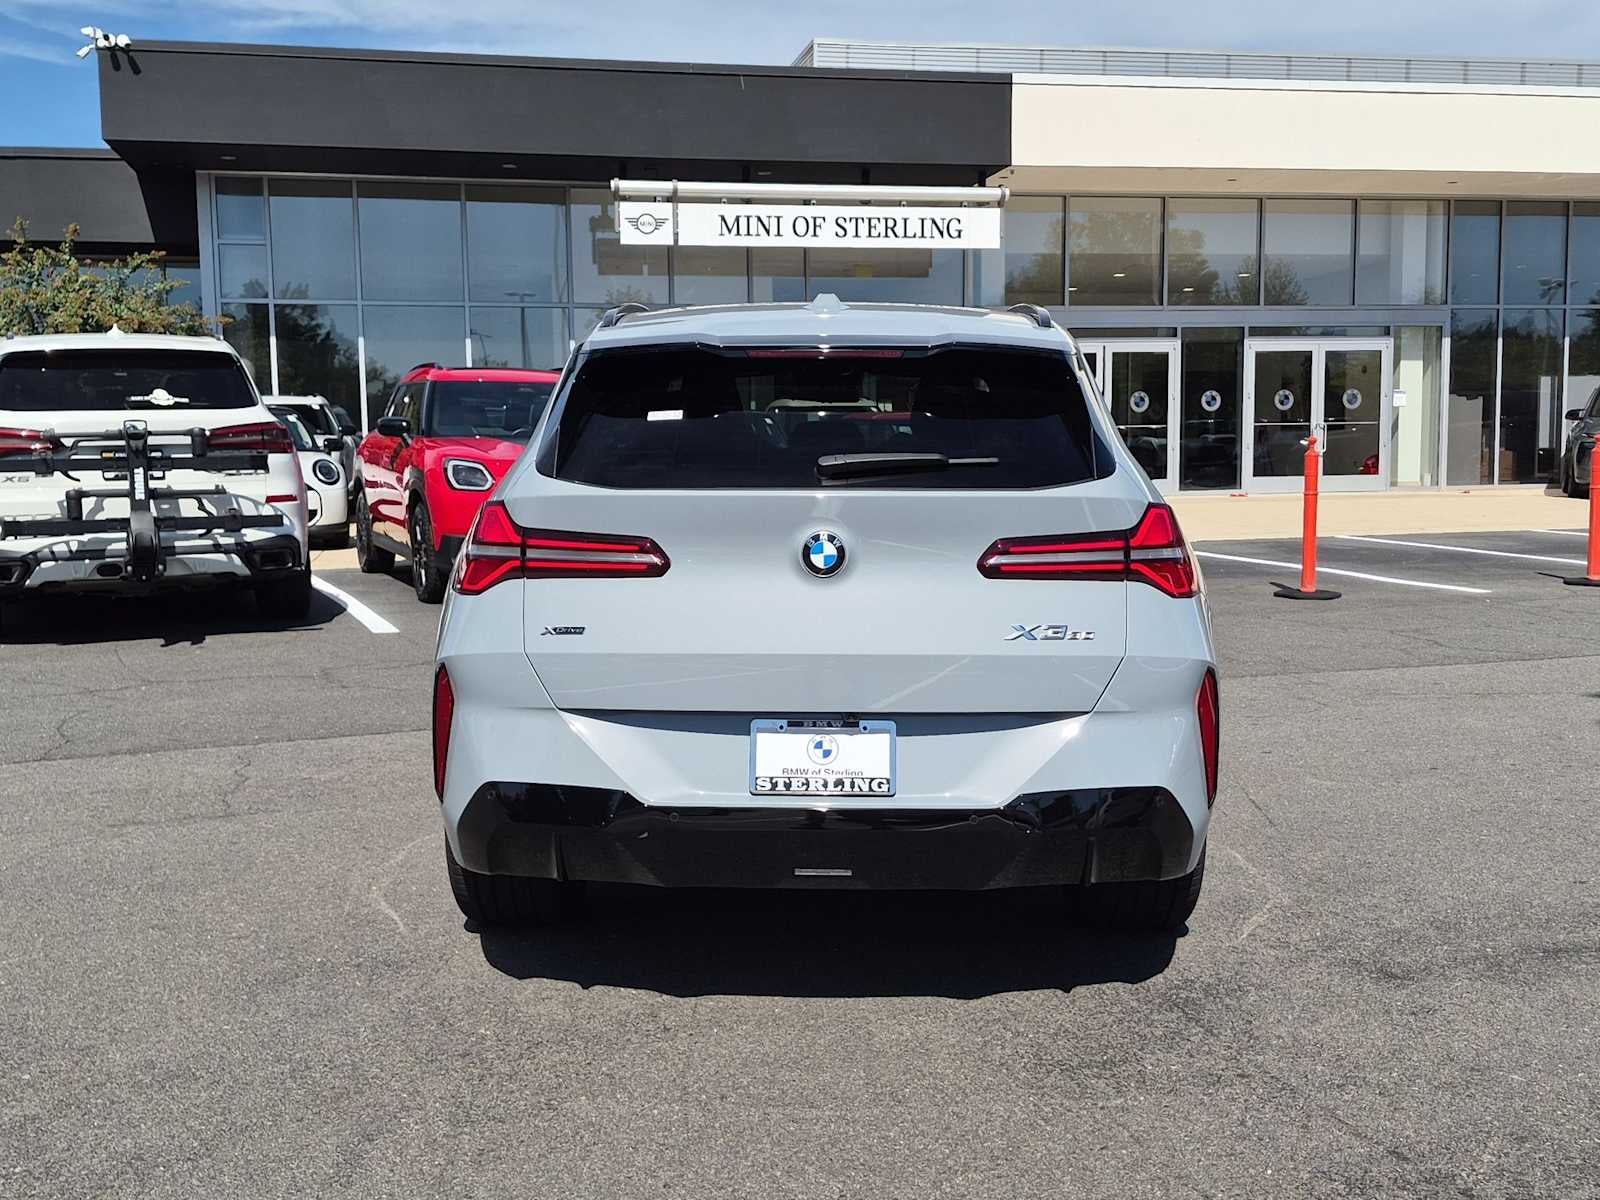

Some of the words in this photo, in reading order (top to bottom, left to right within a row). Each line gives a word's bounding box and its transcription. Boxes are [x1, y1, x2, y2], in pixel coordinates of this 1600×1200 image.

[718, 214, 783, 237] MINI
[793, 215, 826, 238] OF
[835, 216, 963, 239] STERLING
[806, 532, 842, 548] BMW
[802, 720, 844, 728] BMW
[782, 767, 809, 776] BMW
[811, 767, 821, 776] of
[755, 777, 890, 792] STERLING
